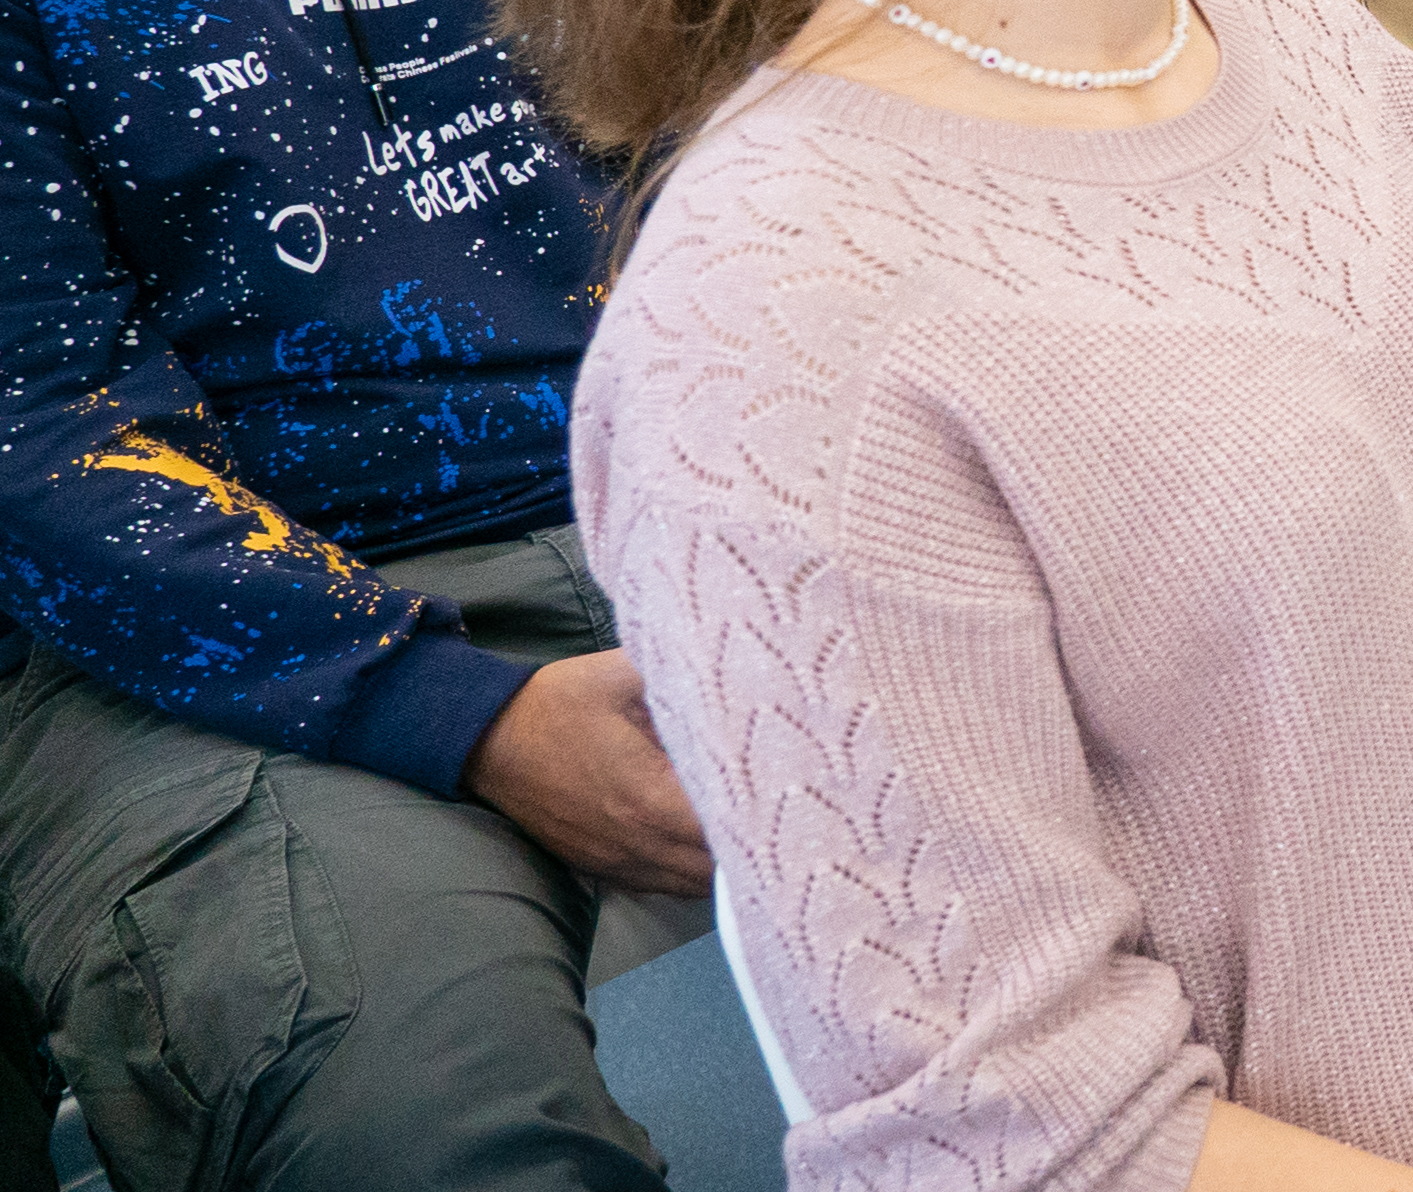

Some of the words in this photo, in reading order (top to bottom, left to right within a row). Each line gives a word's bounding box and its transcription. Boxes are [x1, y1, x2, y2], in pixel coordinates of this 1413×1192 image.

[189, 51, 268, 102] ING
[438, 102, 507, 143] make
[404, 151, 500, 222] GREAT
